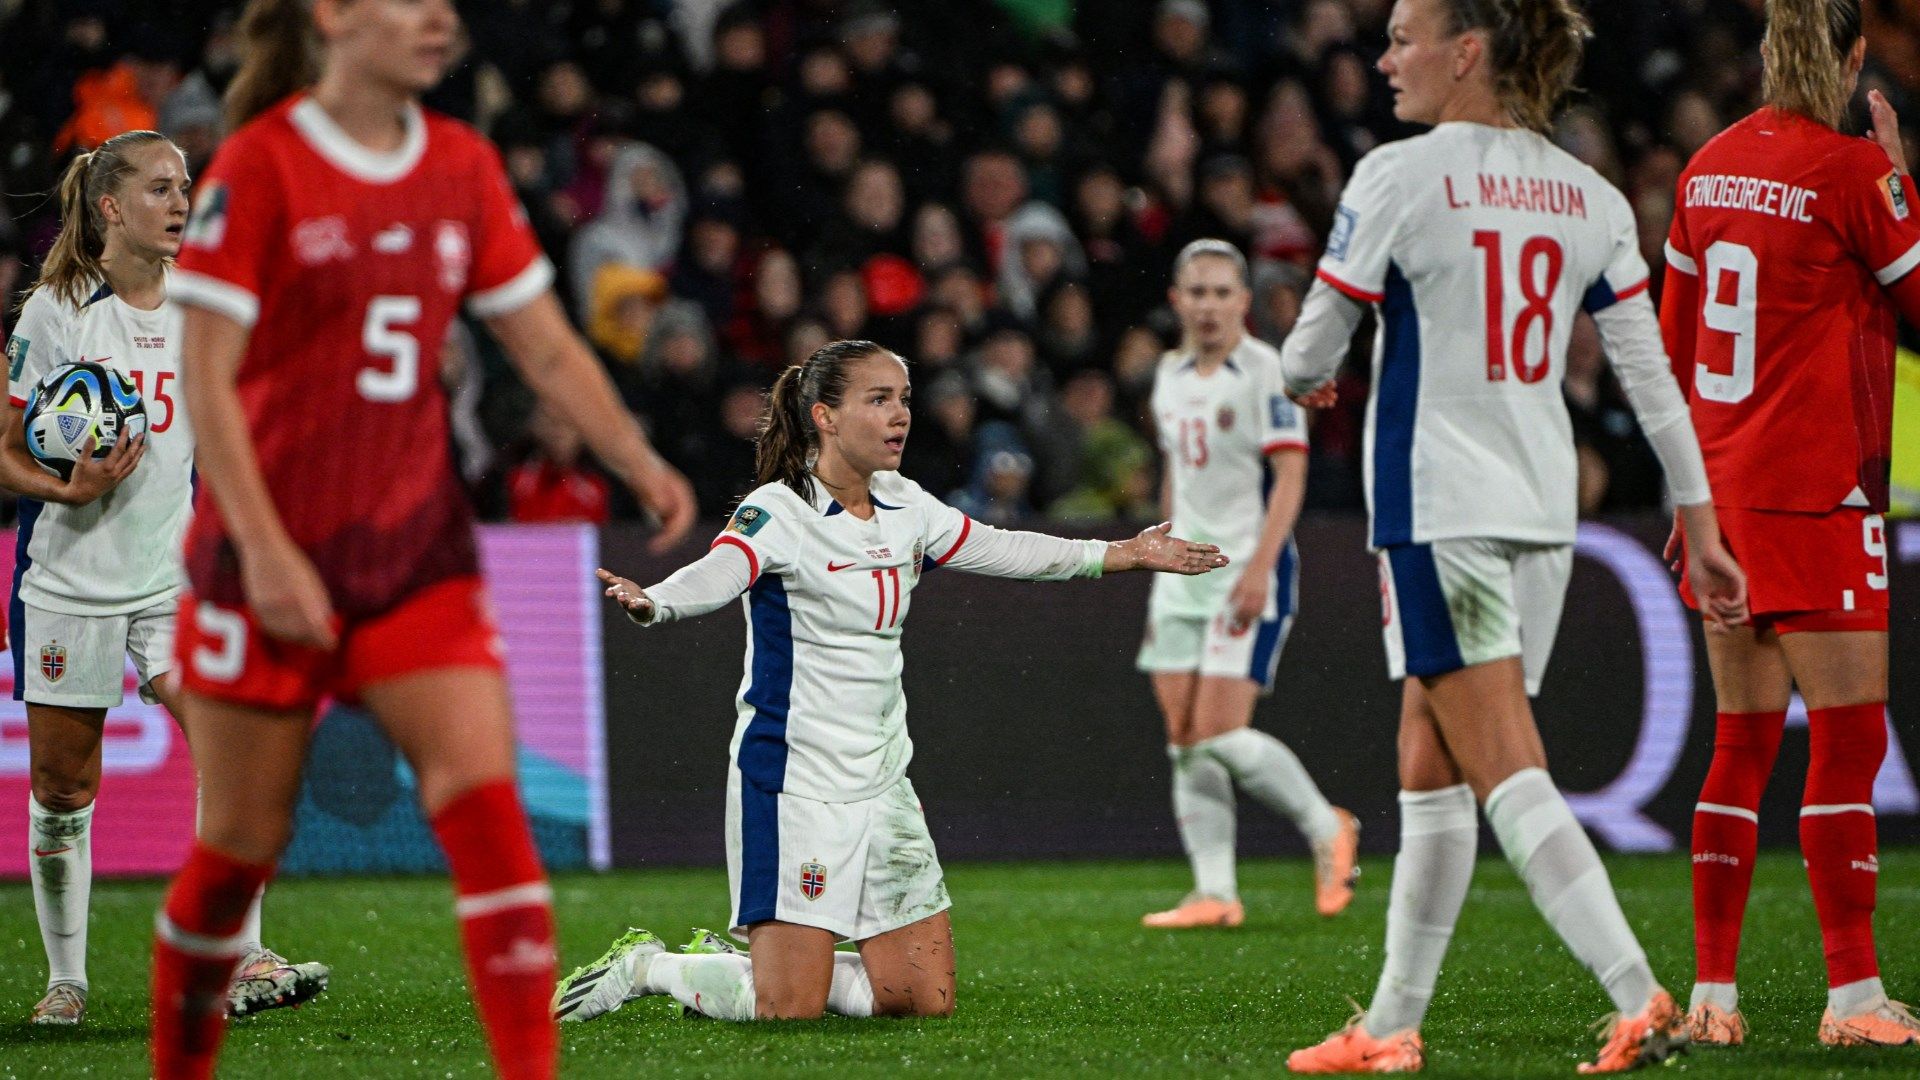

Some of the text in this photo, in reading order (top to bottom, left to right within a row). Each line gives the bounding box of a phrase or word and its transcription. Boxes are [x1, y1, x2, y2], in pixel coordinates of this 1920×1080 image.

[1444, 173, 1587, 219] L. MAANUM
[1685, 174, 1817, 222] CRNOGORCEVIC
[1472, 228, 1564, 384] 18
[1695, 240, 1758, 404] 9
[355, 295, 422, 402] 5
[1179, 417, 1209, 469] 13
[1862, 514, 1888, 591] 9
[872, 567, 900, 631] 11
